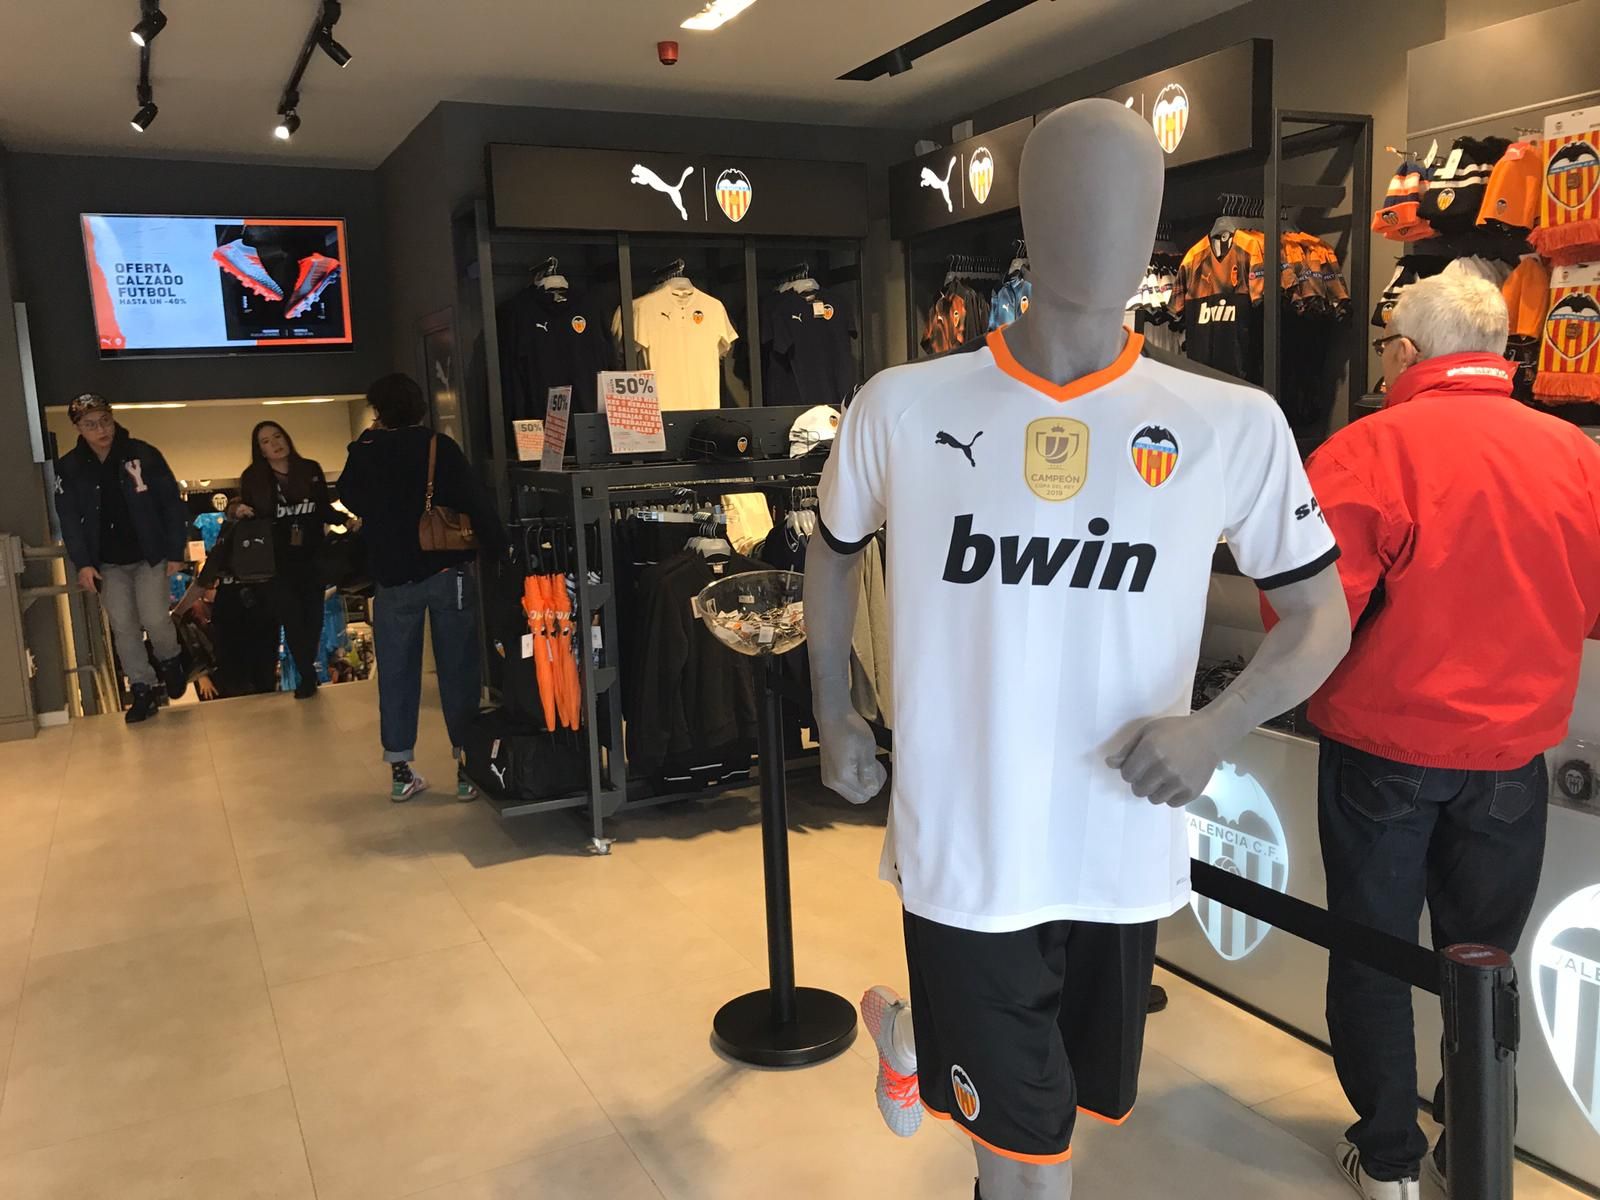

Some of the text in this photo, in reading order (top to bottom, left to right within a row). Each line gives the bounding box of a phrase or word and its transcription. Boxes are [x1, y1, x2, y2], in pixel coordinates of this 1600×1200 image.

[115, 263, 172, 273] OFERTA
[115, 275, 184, 285] CALZADO
[118, 287, 176, 297] FUTBOL
[614, 377, 654, 395] 50%
[552, 393, 568, 412] 50%
[521, 423, 542, 432] 50%
[942, 513, 1157, 592] bwin
[1187, 817, 1248, 849] ALENCIA
